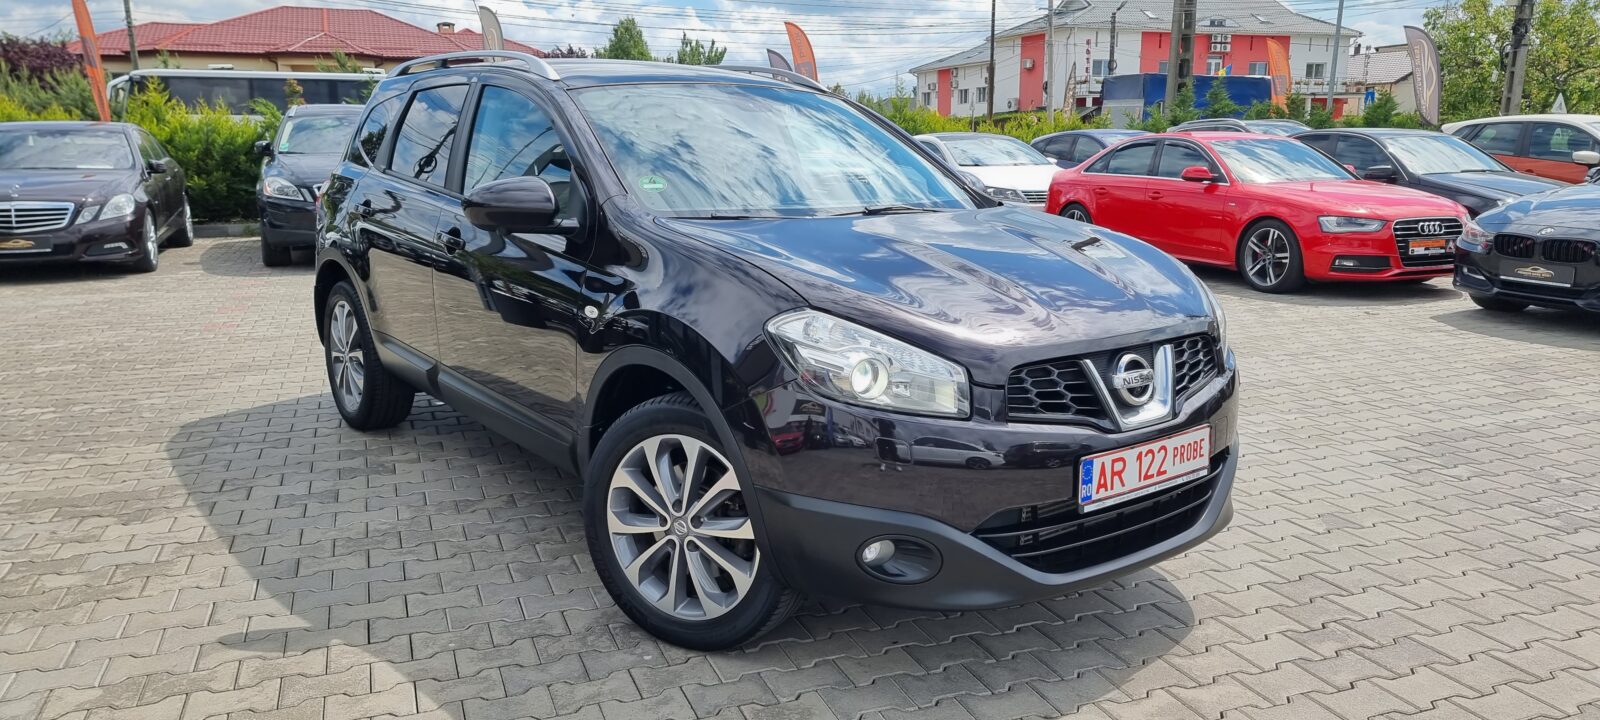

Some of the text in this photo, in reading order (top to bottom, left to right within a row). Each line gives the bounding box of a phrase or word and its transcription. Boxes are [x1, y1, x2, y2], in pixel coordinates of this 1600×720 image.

[1081, 483, 1092, 499] RO
[1095, 456, 1127, 495] AR
[1136, 445, 1168, 482] 122
[1173, 438, 1205, 467] PROBE
